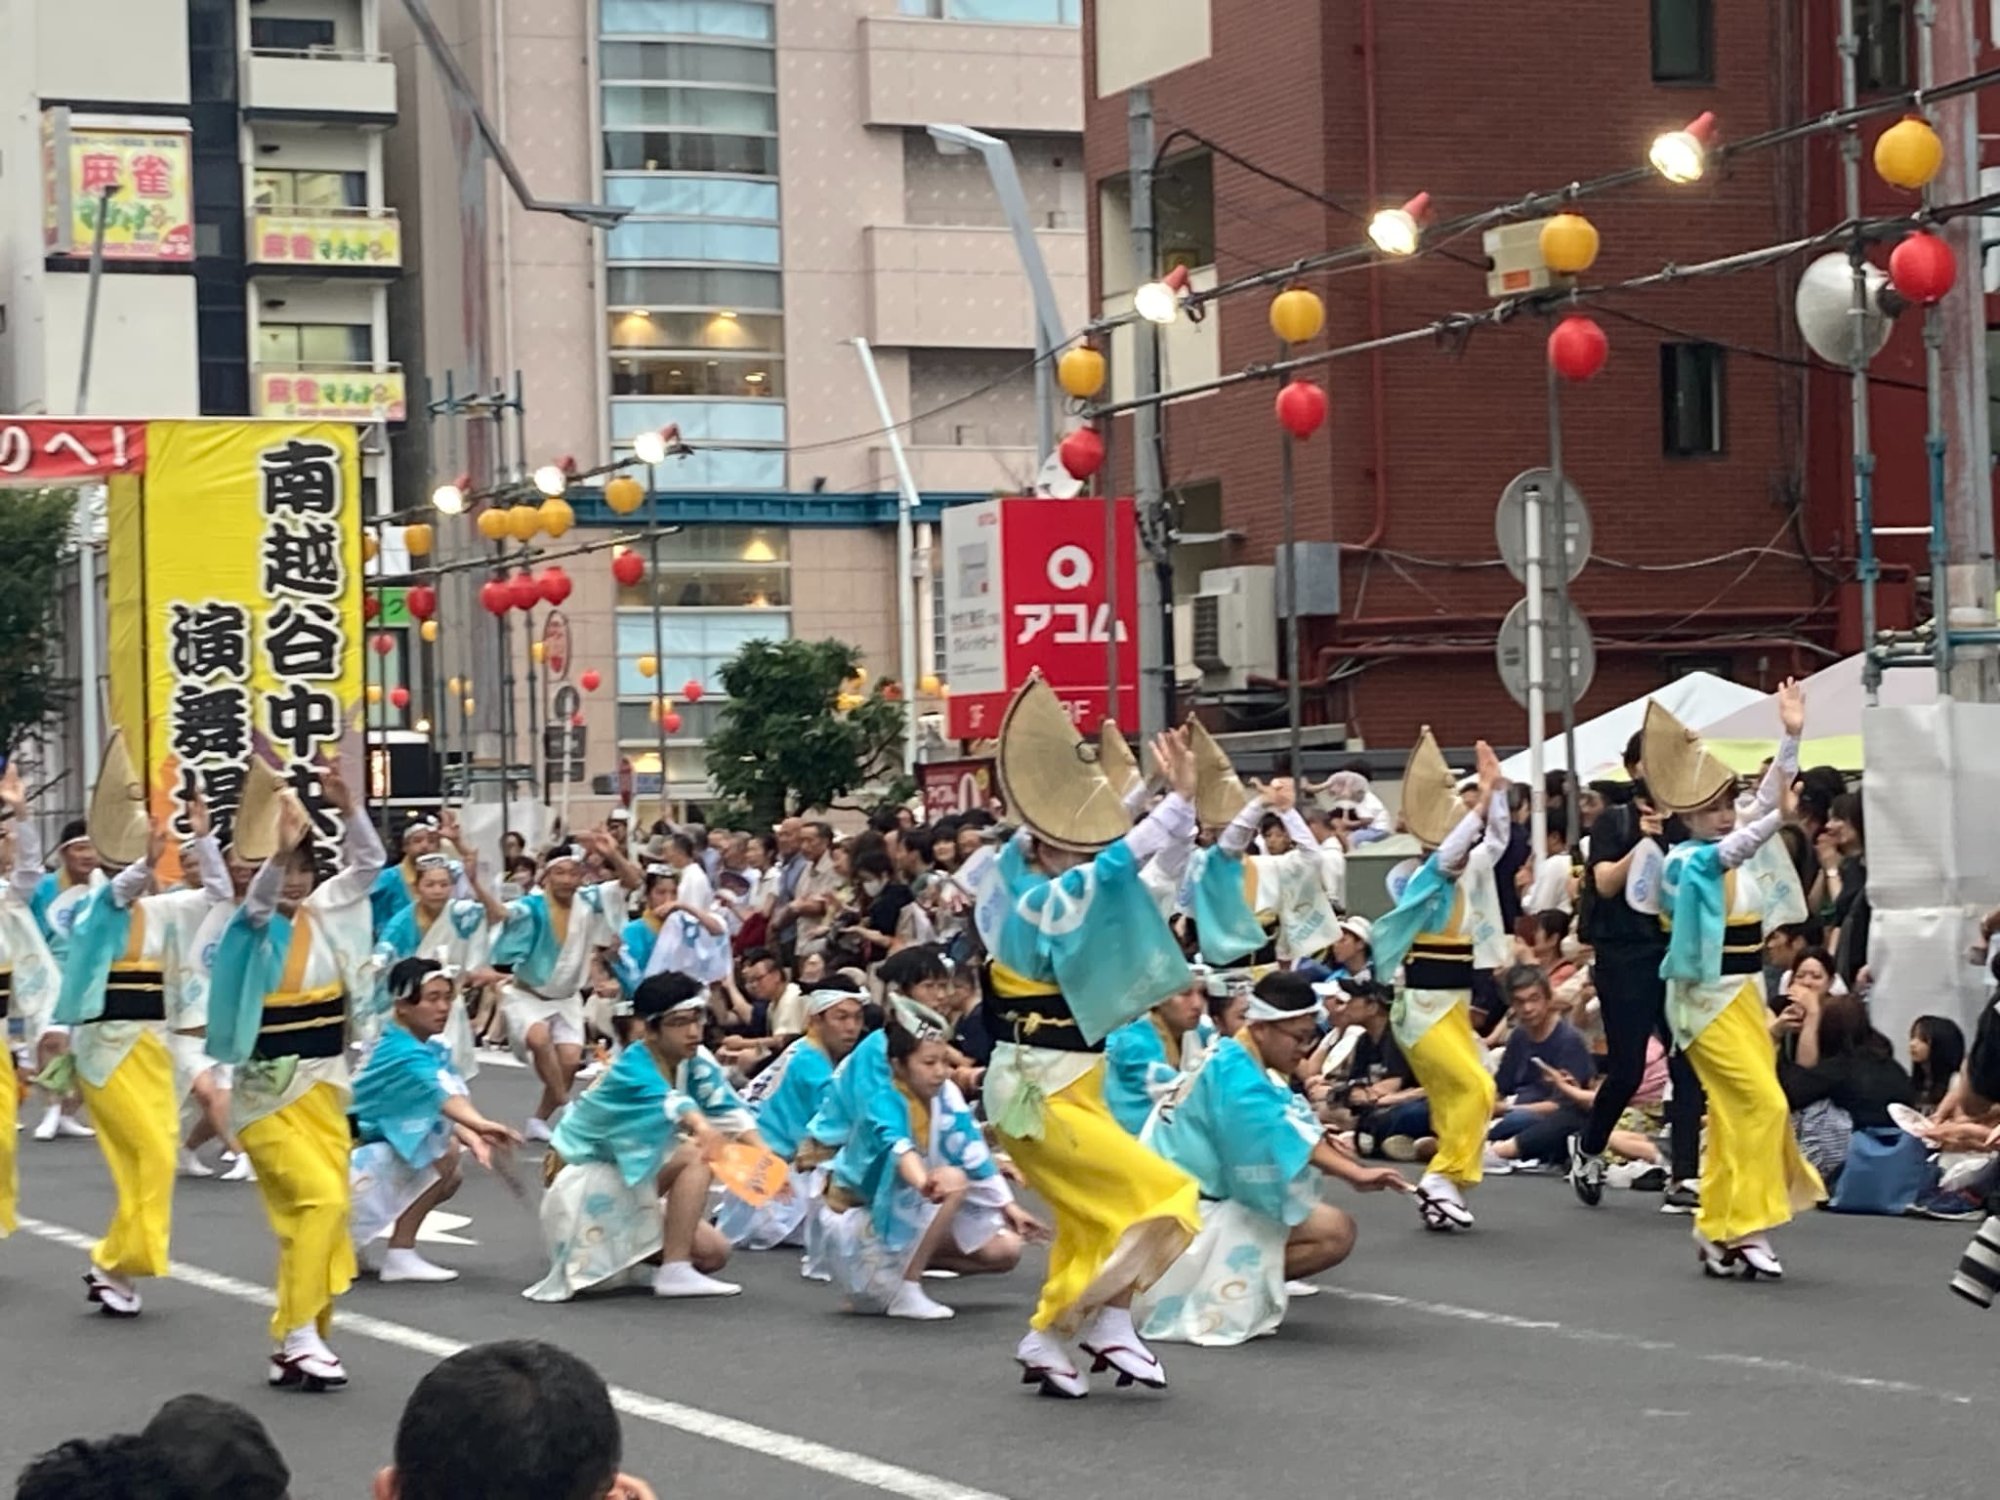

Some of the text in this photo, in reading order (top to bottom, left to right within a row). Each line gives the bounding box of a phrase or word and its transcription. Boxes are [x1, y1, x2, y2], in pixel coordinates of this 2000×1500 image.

[81, 153, 173, 199] 麻雀
[1014, 602, 1129, 645] アコム
